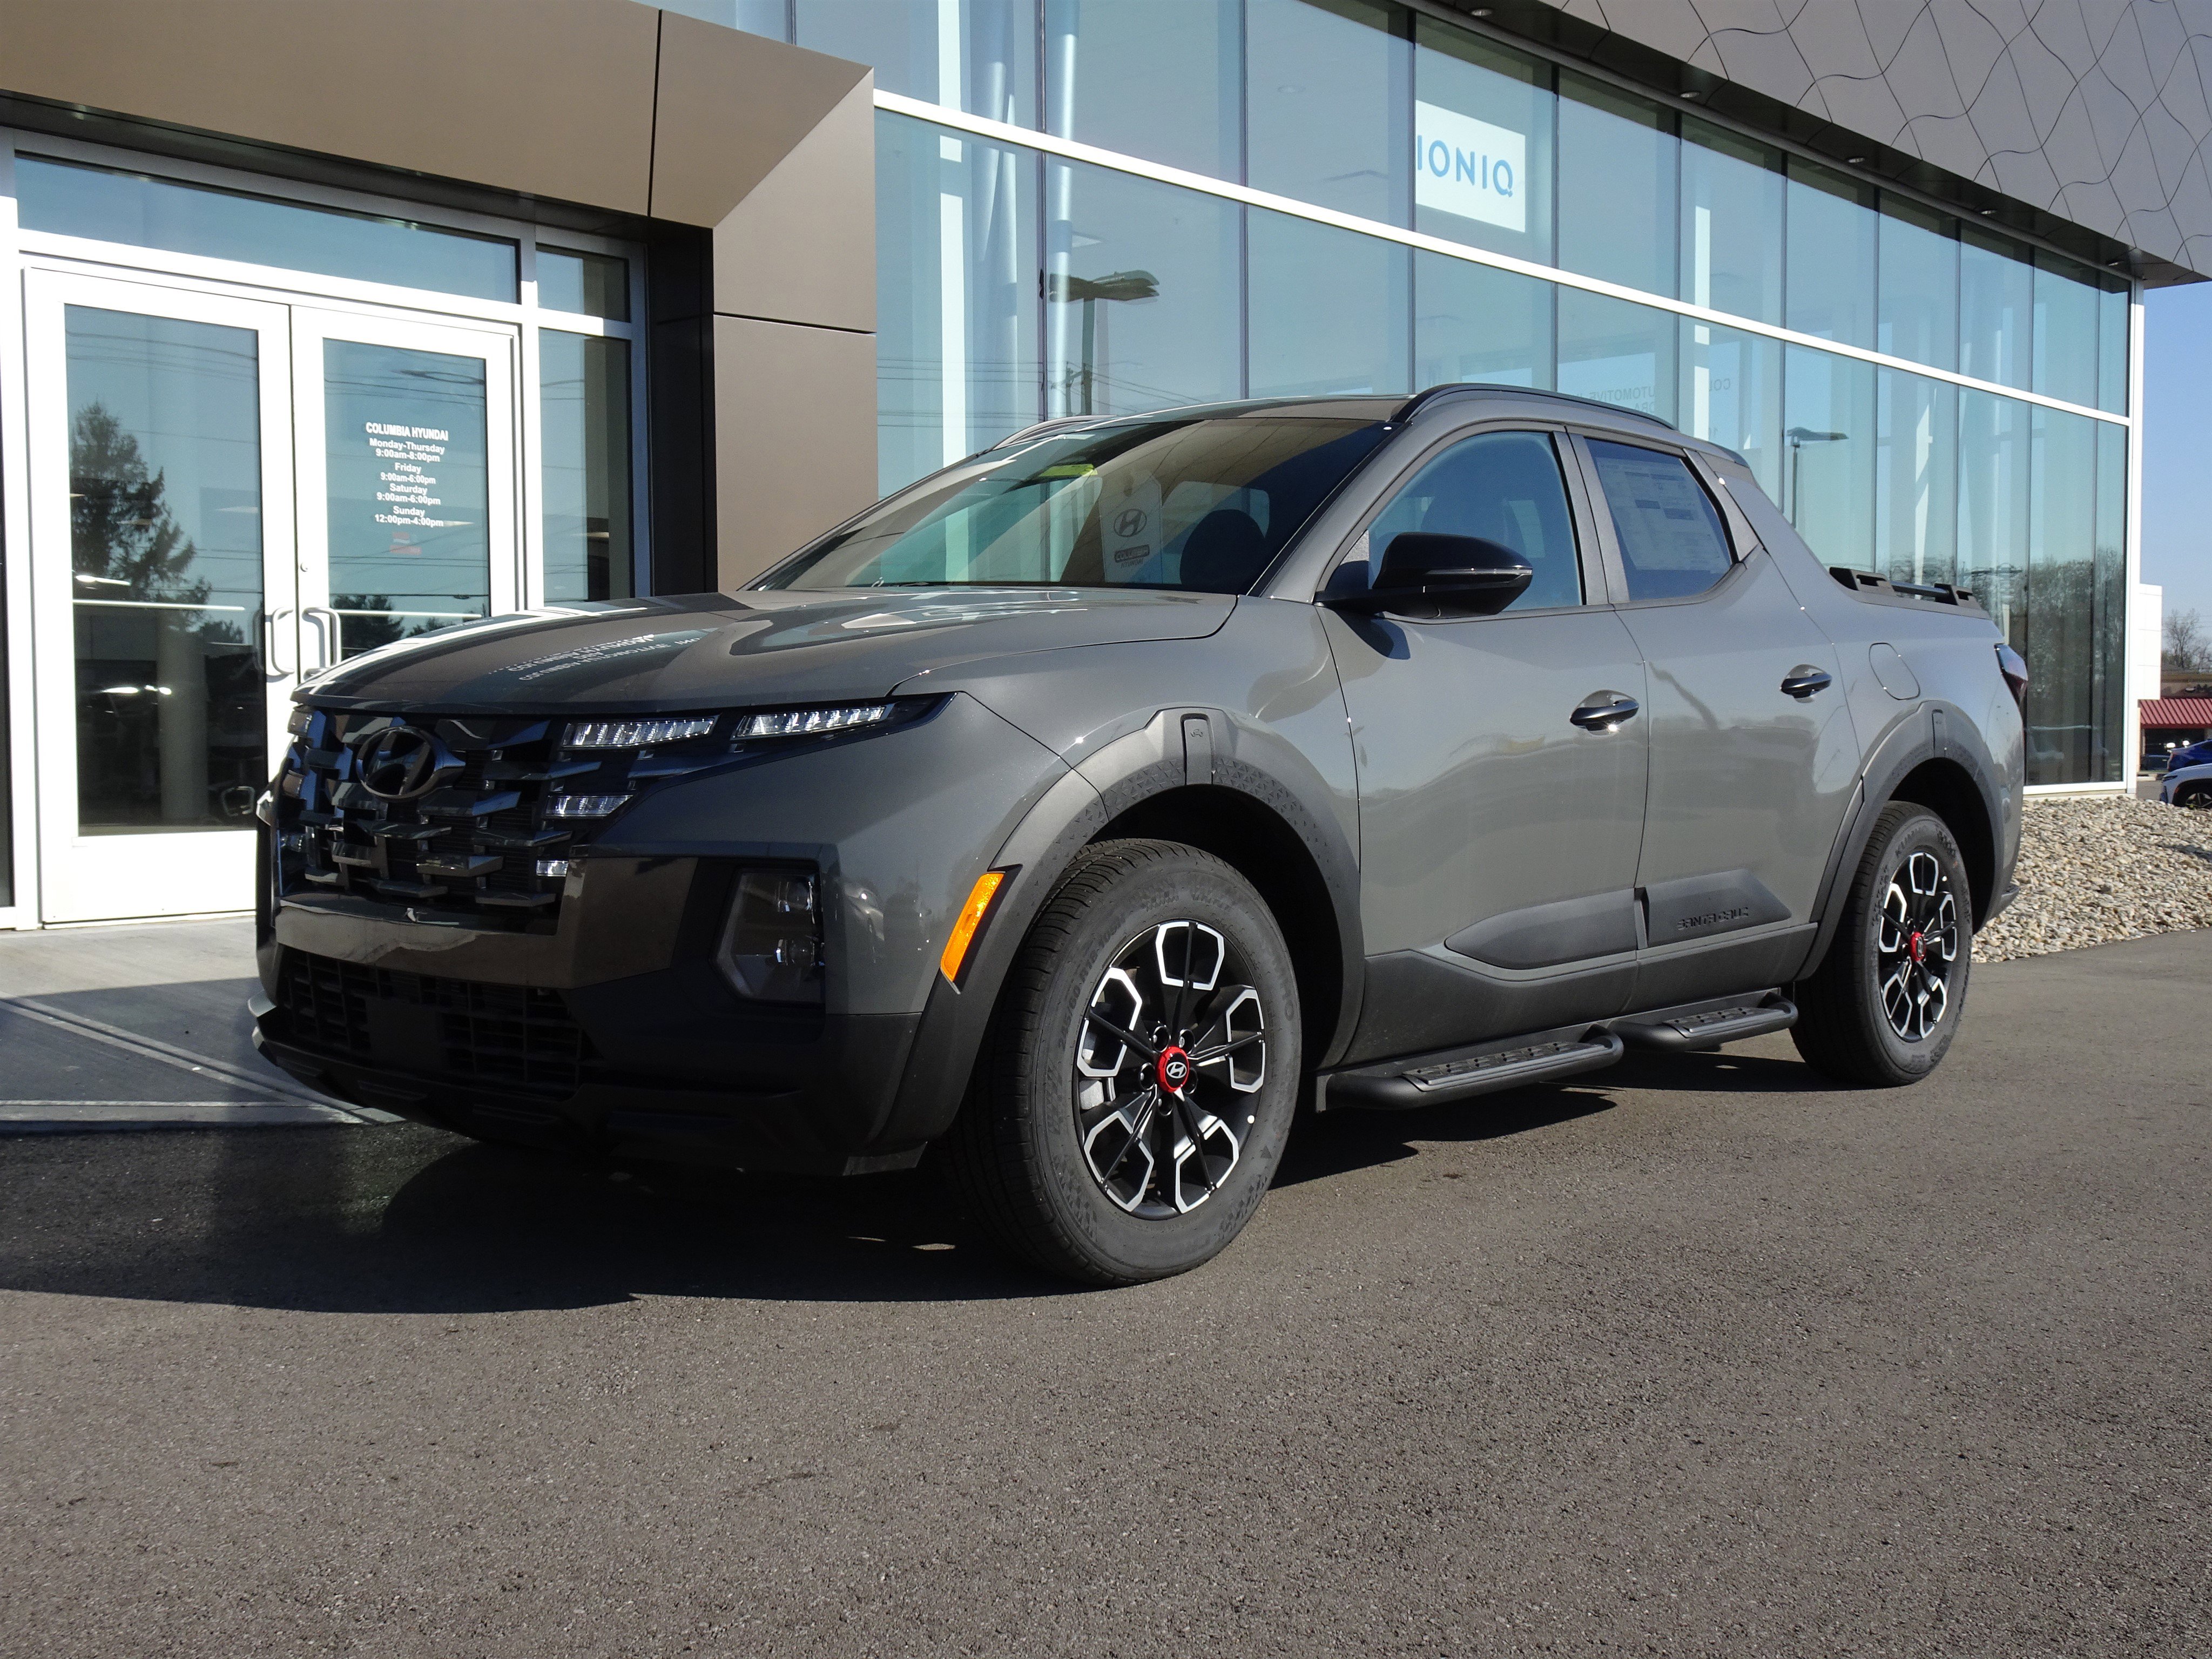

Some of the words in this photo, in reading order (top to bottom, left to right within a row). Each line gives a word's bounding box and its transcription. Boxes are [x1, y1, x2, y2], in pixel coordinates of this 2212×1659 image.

[1418, 135, 1513, 198] IONIQ
[366, 422, 410, 437] COLUMBIA
[412, 427, 448, 441] HYUNDAI
[369, 438, 444, 455] Monday-Thursday
[375, 448, 440, 463] 9:00am-8:00pm
[395, 462, 421, 474] Friday
[380, 472, 436, 485] 9:00am-6:00pm
[390, 483, 427, 496] Saturday
[376, 492, 441, 505] 9:00am-6:00pm
[393, 505, 425, 517] Sunday
[375, 514, 444, 528] 12:00pm-4:00pm
